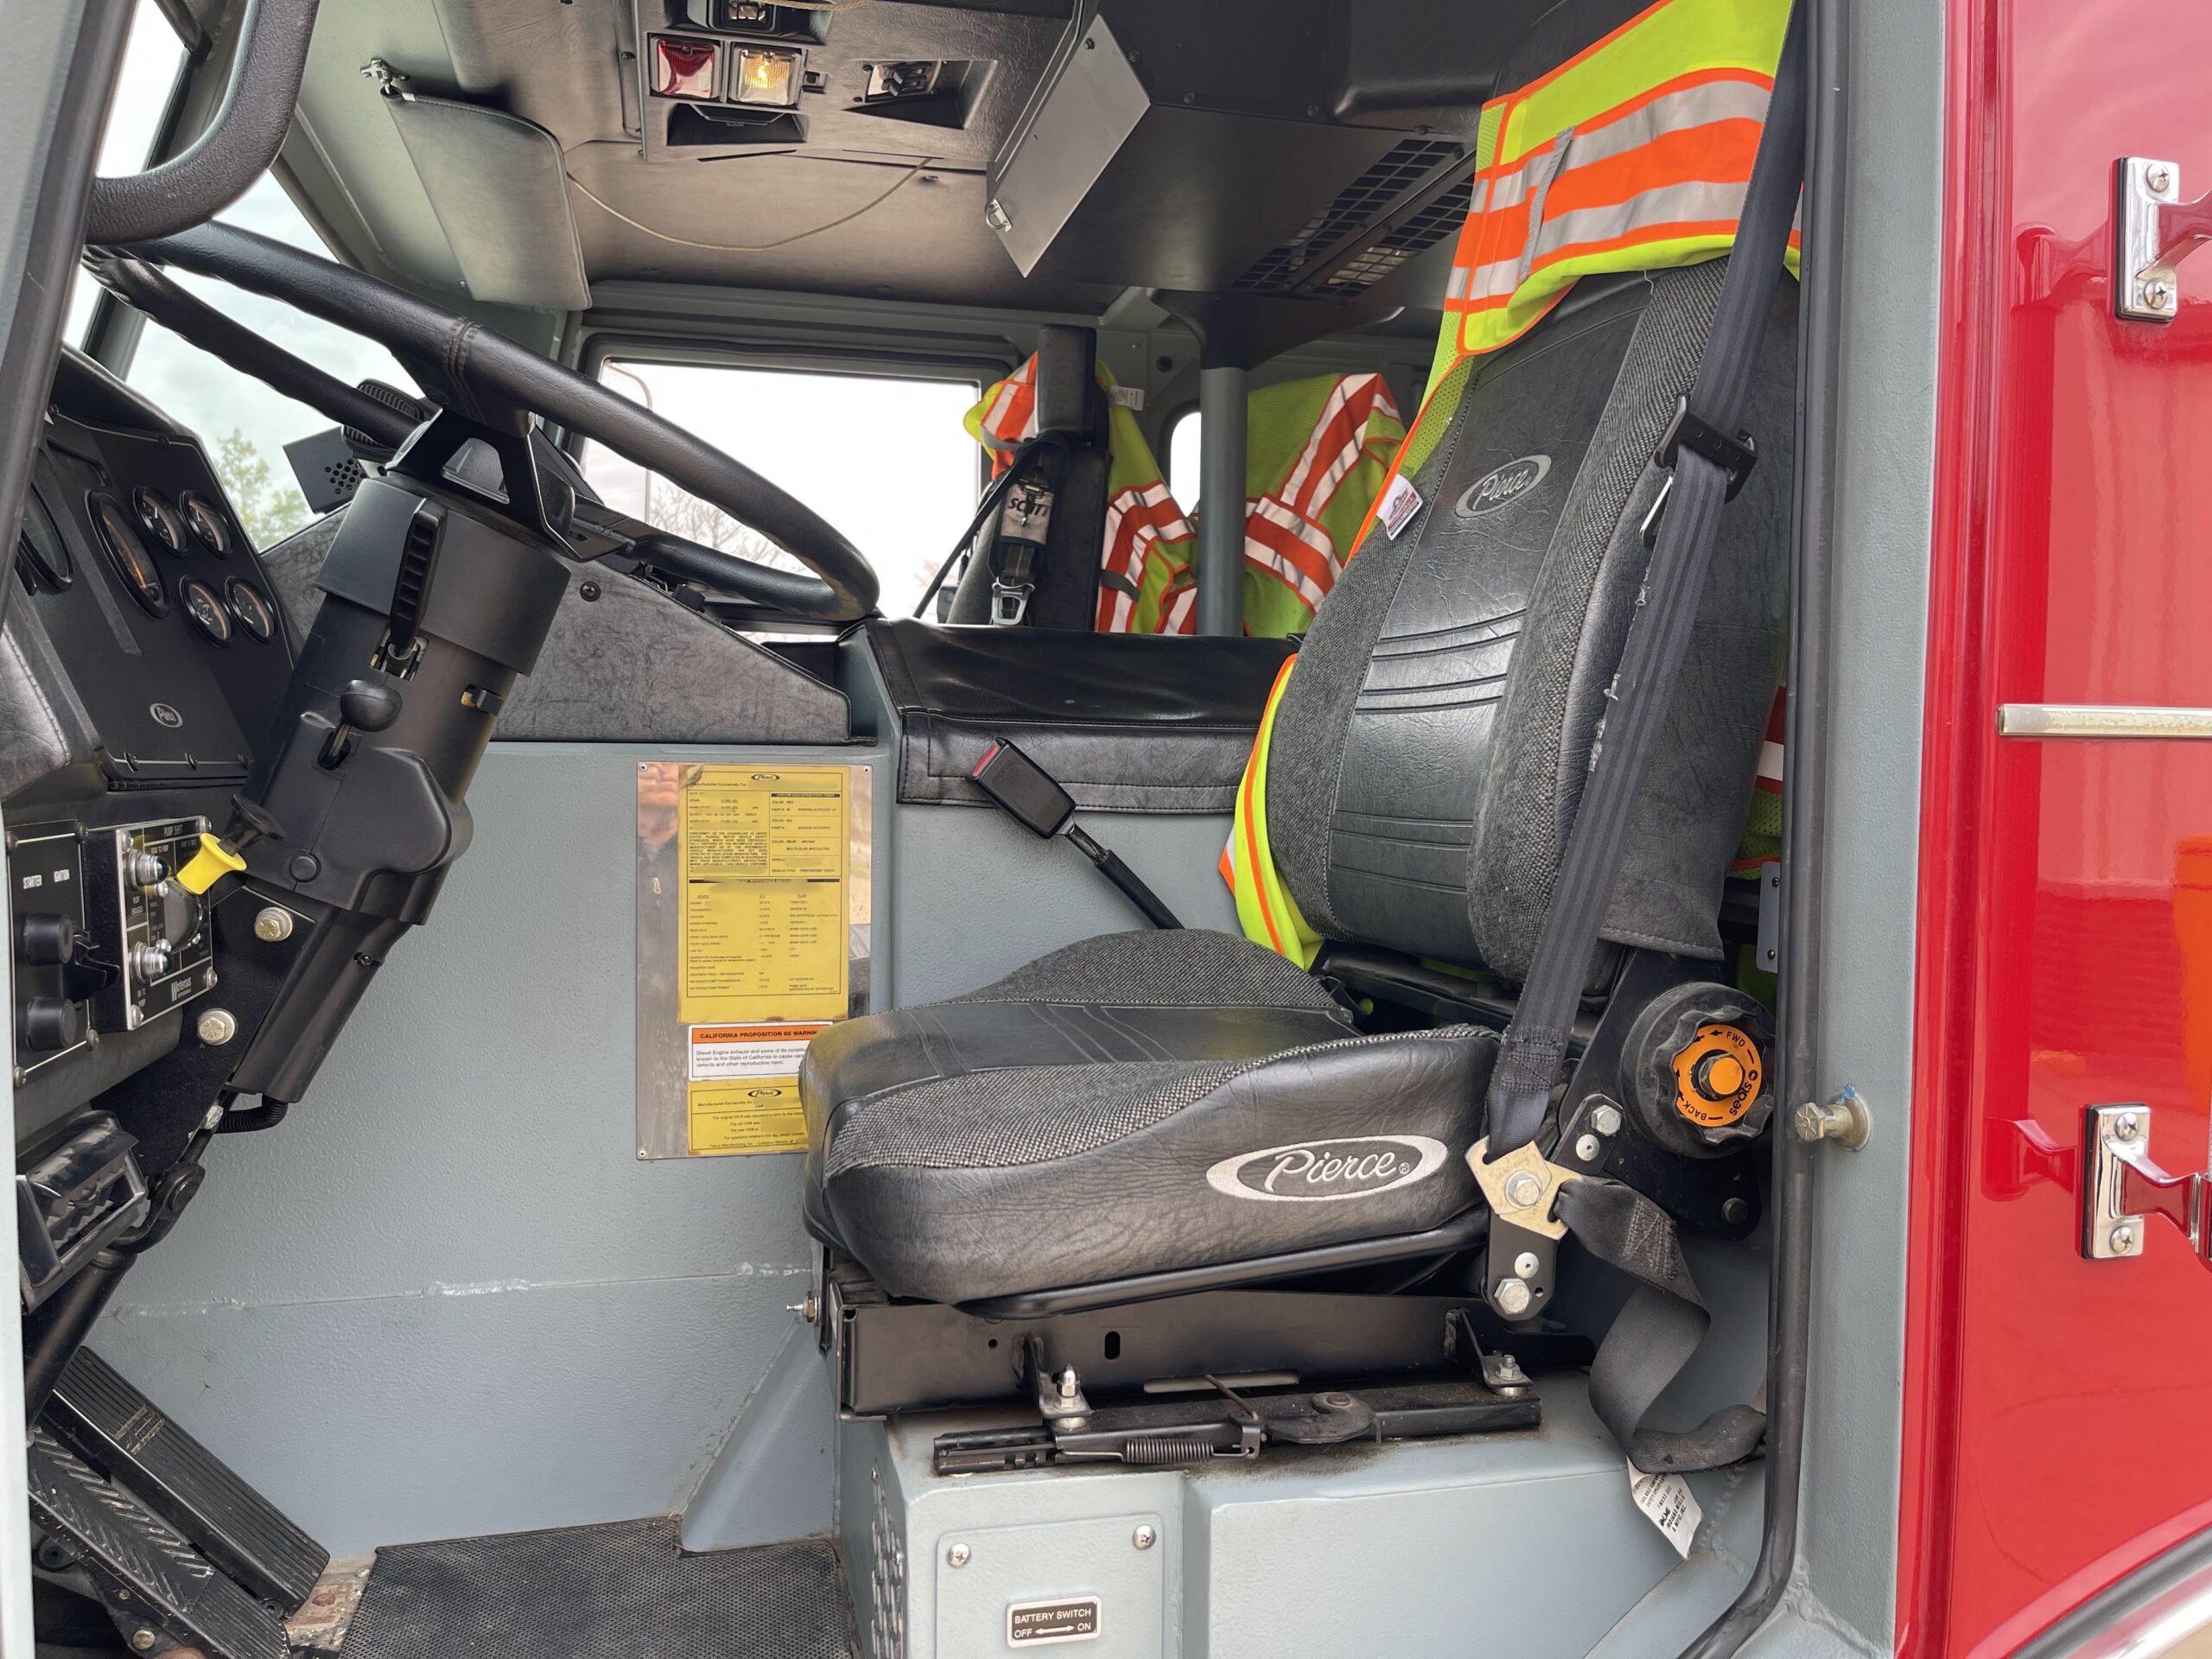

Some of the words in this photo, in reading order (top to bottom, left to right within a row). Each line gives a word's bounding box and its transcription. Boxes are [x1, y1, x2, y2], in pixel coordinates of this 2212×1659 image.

[1472, 468, 1529, 510] Pierce
[23, 874, 42, 889] STARTER
[1726, 1031, 1745, 1047] FWD
[1729, 1082, 1752, 1116] seats
[1683, 1100, 1707, 1120] BACK
[1264, 1150, 1396, 1192] Pierce
[1666, 1508, 1677, 1529] INDIANA
[1676, 1495, 1685, 1509] MILLS
[1014, 1612, 1054, 1624] BATTERY
[1056, 1608, 1091, 1619] SWITCH
[1014, 1628, 1032, 1638] OFF
[1077, 1623, 1091, 1631] ON
